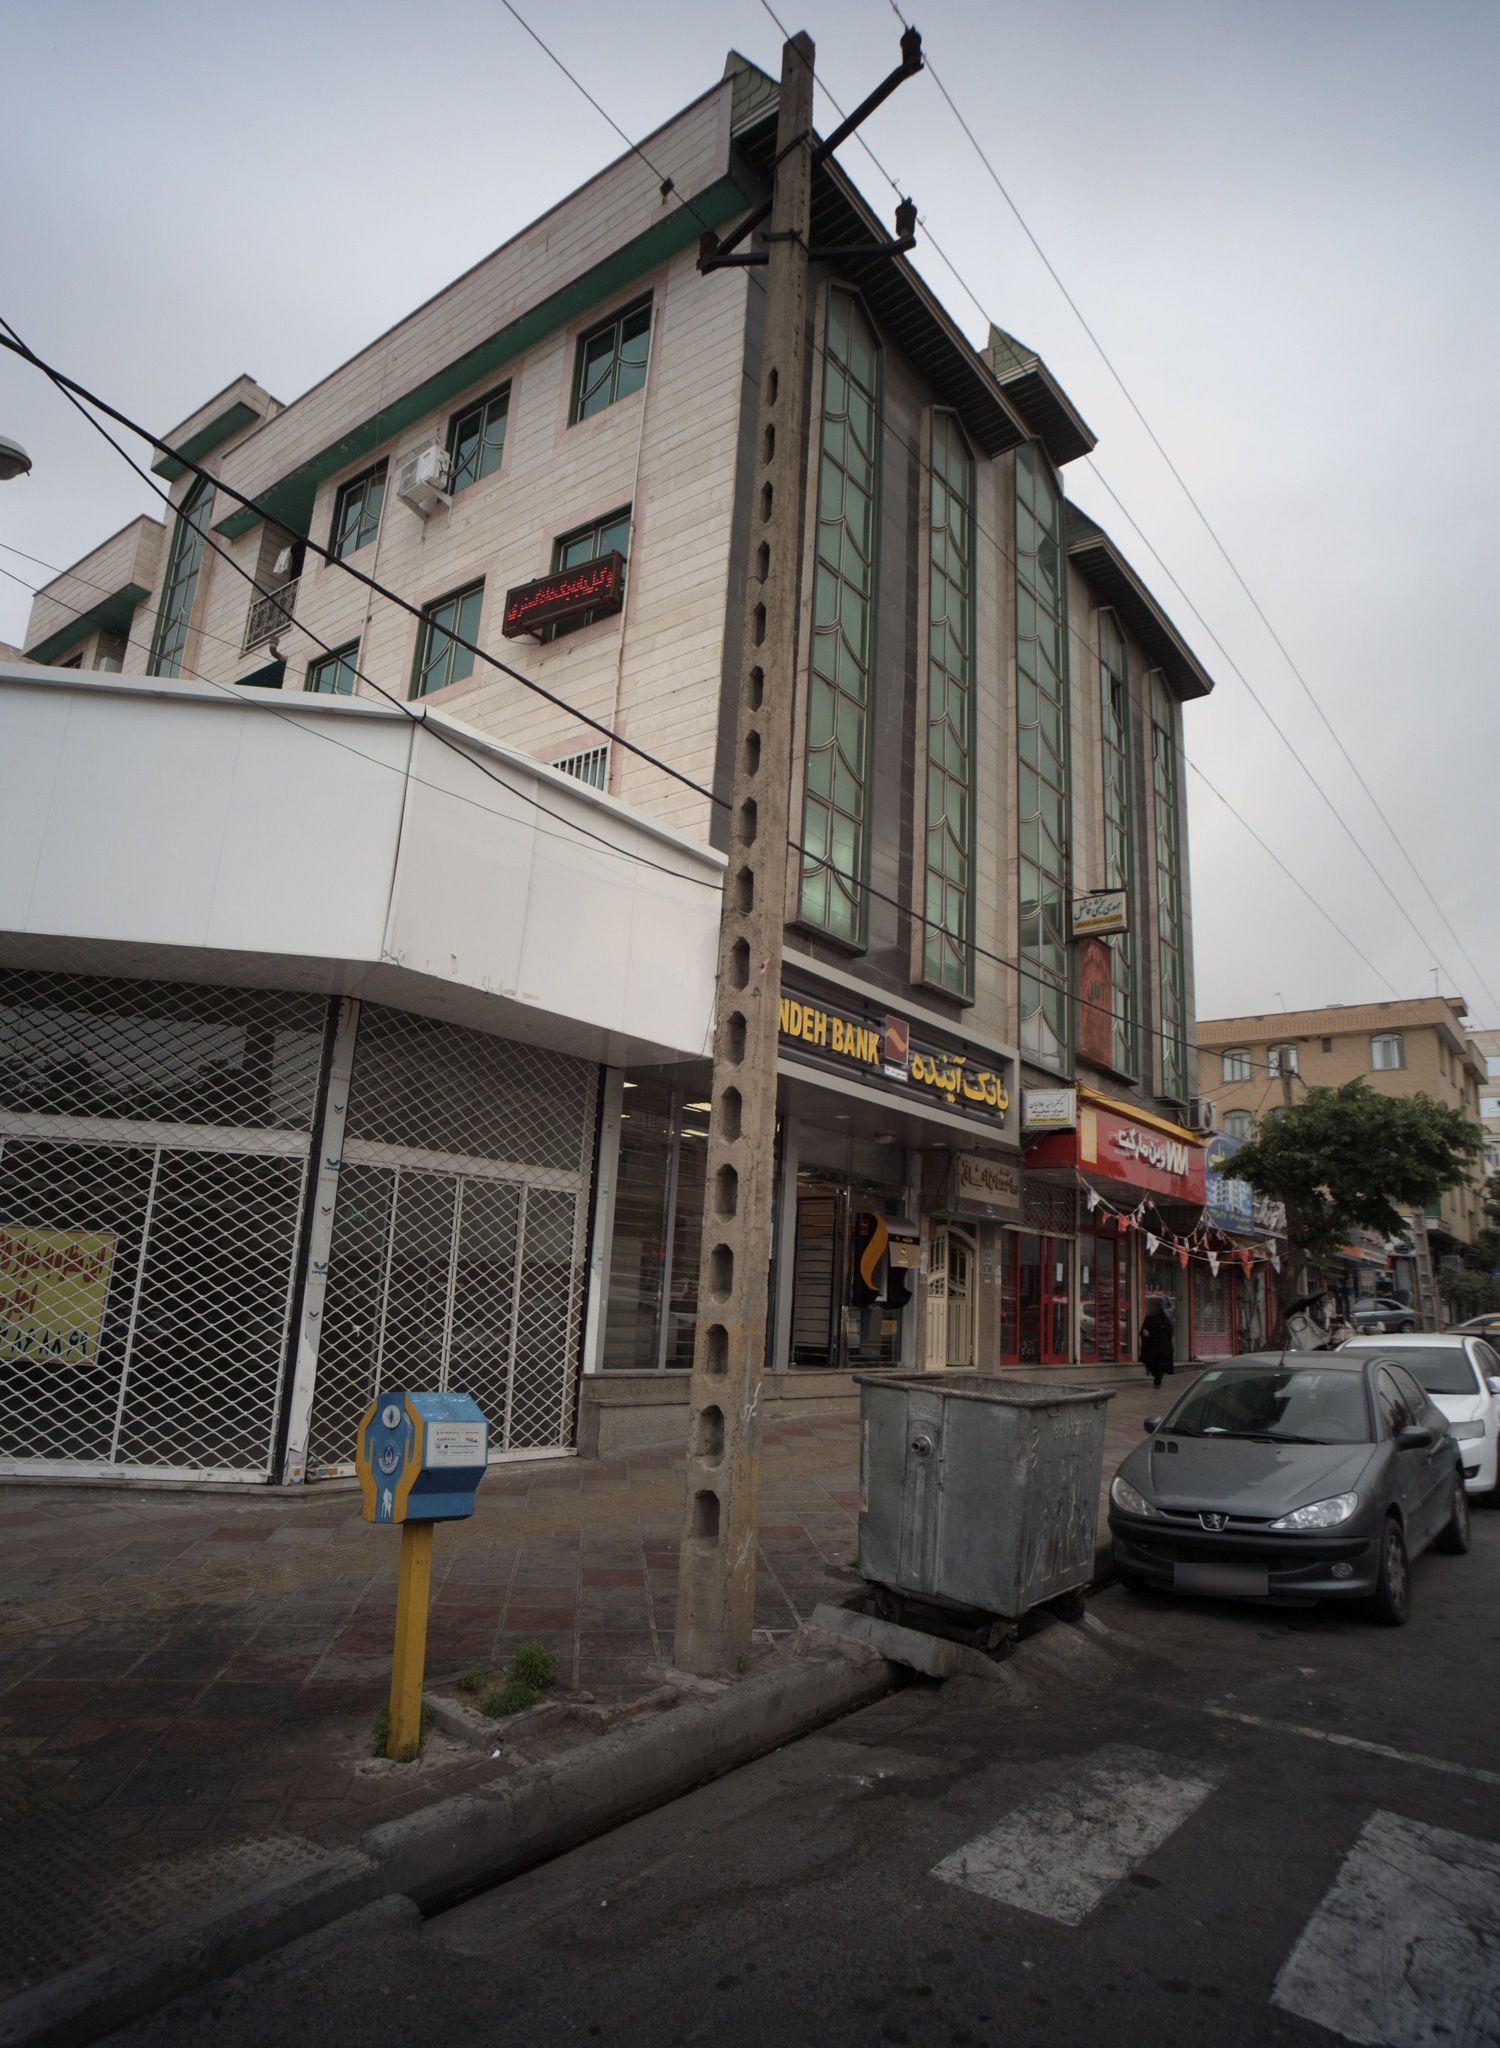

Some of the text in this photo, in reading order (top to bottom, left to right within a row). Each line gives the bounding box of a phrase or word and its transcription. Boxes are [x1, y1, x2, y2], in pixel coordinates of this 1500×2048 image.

[832, 1016, 880, 1065] BANK
[911, 1054, 1009, 1120] بانک آینده
[1118, 1128, 1148, 1160] مارکت
